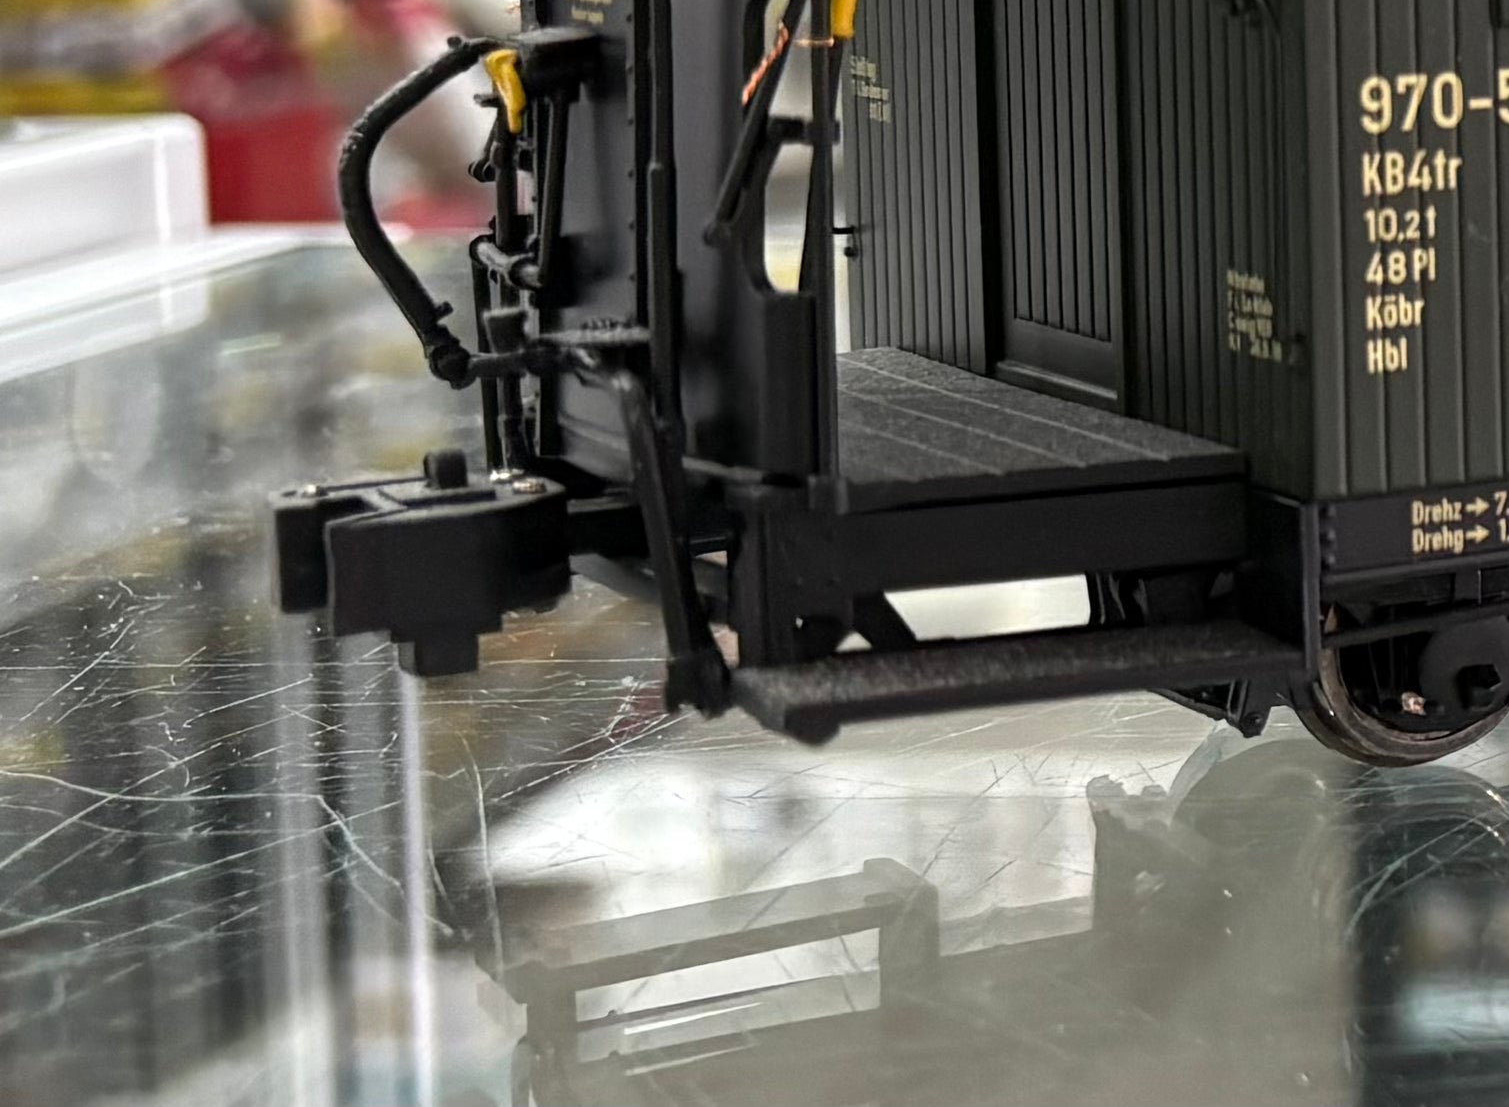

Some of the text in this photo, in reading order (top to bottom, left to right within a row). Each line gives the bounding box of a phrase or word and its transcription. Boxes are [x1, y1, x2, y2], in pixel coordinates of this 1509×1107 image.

[1361, 148, 1463, 196] KB4tr
[1366, 292, 1426, 331] Köbr
[1366, 337, 1409, 375] Hbl
[1411, 497, 1463, 526] Drehz
[1411, 525, 1465, 555] Drehg
